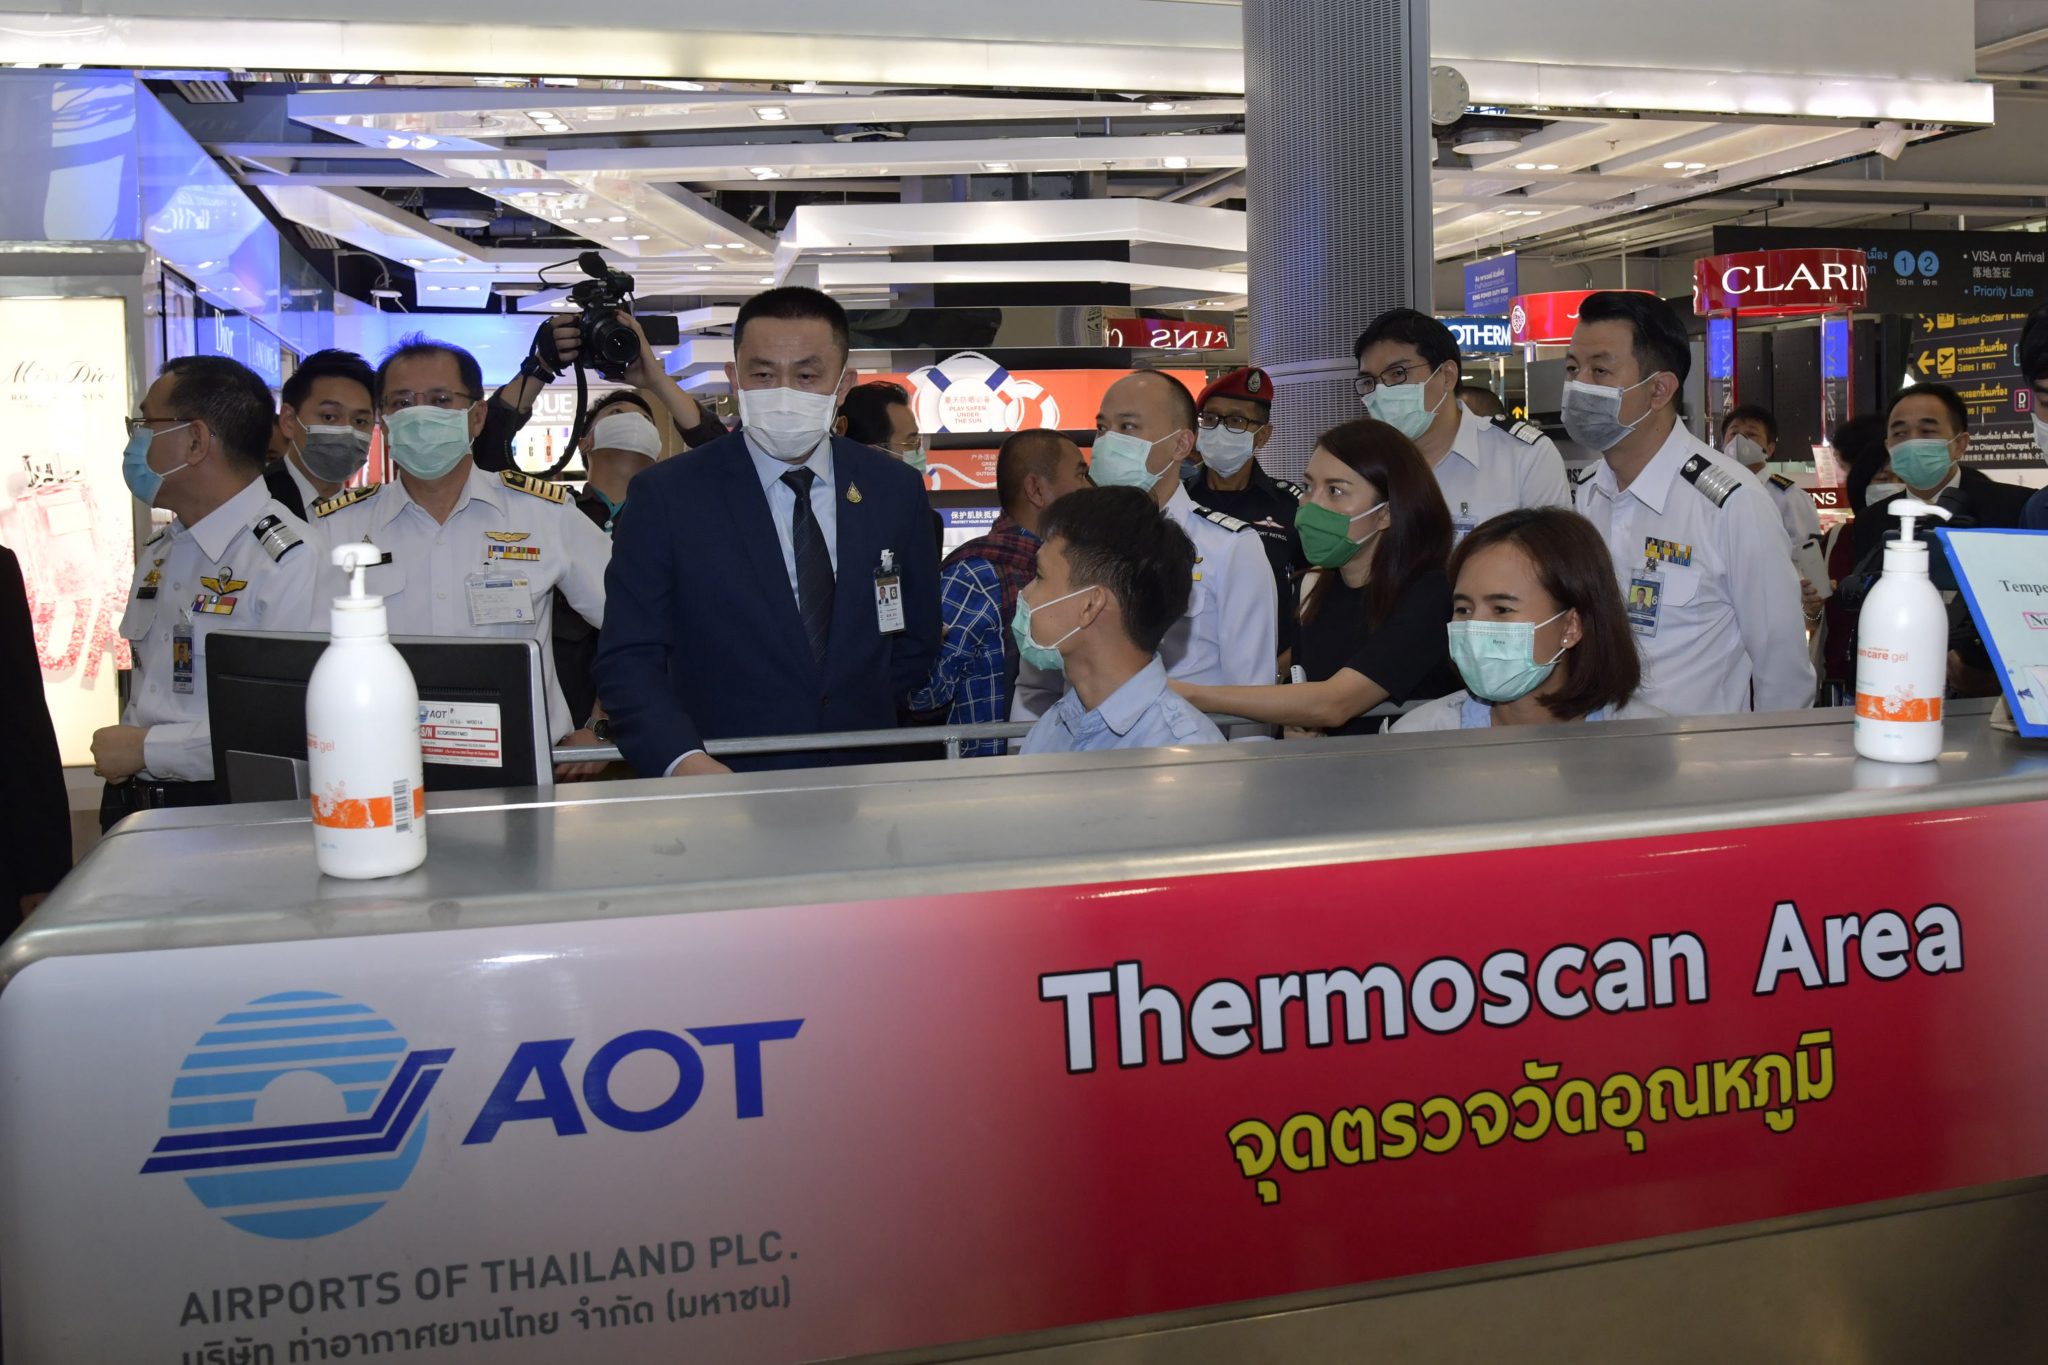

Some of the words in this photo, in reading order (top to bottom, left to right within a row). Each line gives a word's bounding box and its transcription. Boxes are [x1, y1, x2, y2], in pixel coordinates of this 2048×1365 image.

[1971, 250, 1998, 262] VISA
[1999, 252, 2012, 263] on
[2014, 250, 2045, 263] Arrival
[1973, 285, 2008, 300] Priority
[2009, 285, 2034, 297] Lane
[214, 308, 234, 357] Dior
[1957, 363, 1975, 372] Gates
[2018, 392, 2027, 404] D
[890, 589, 897, 598] 6
[1651, 595, 1658, 606] 6
[515, 608, 523, 619] 3
[1891, 652, 1909, 663] gel
[429, 709, 447, 719] AOT
[320, 741, 335, 753] gel
[1040, 932, 1707, 1072] Thermoscan
[1754, 901, 1963, 994] Area
[463, 1018, 804, 1145] AOT
[1228, 1029, 1834, 1204] จุดตรวจวัดอุณหภูมิ
[179, 1264, 402, 1328] AIRPORTS
[414, 1263, 469, 1301] OF
[480, 1240, 696, 1294] THAILAND
[708, 1230, 798, 1270] PLC.
[288, 1305, 560, 1364] ท่าอากาศยานไทย
[569, 1295, 655, 1331] จำกัด
[666, 1274, 791, 1323] (มหาชน)
